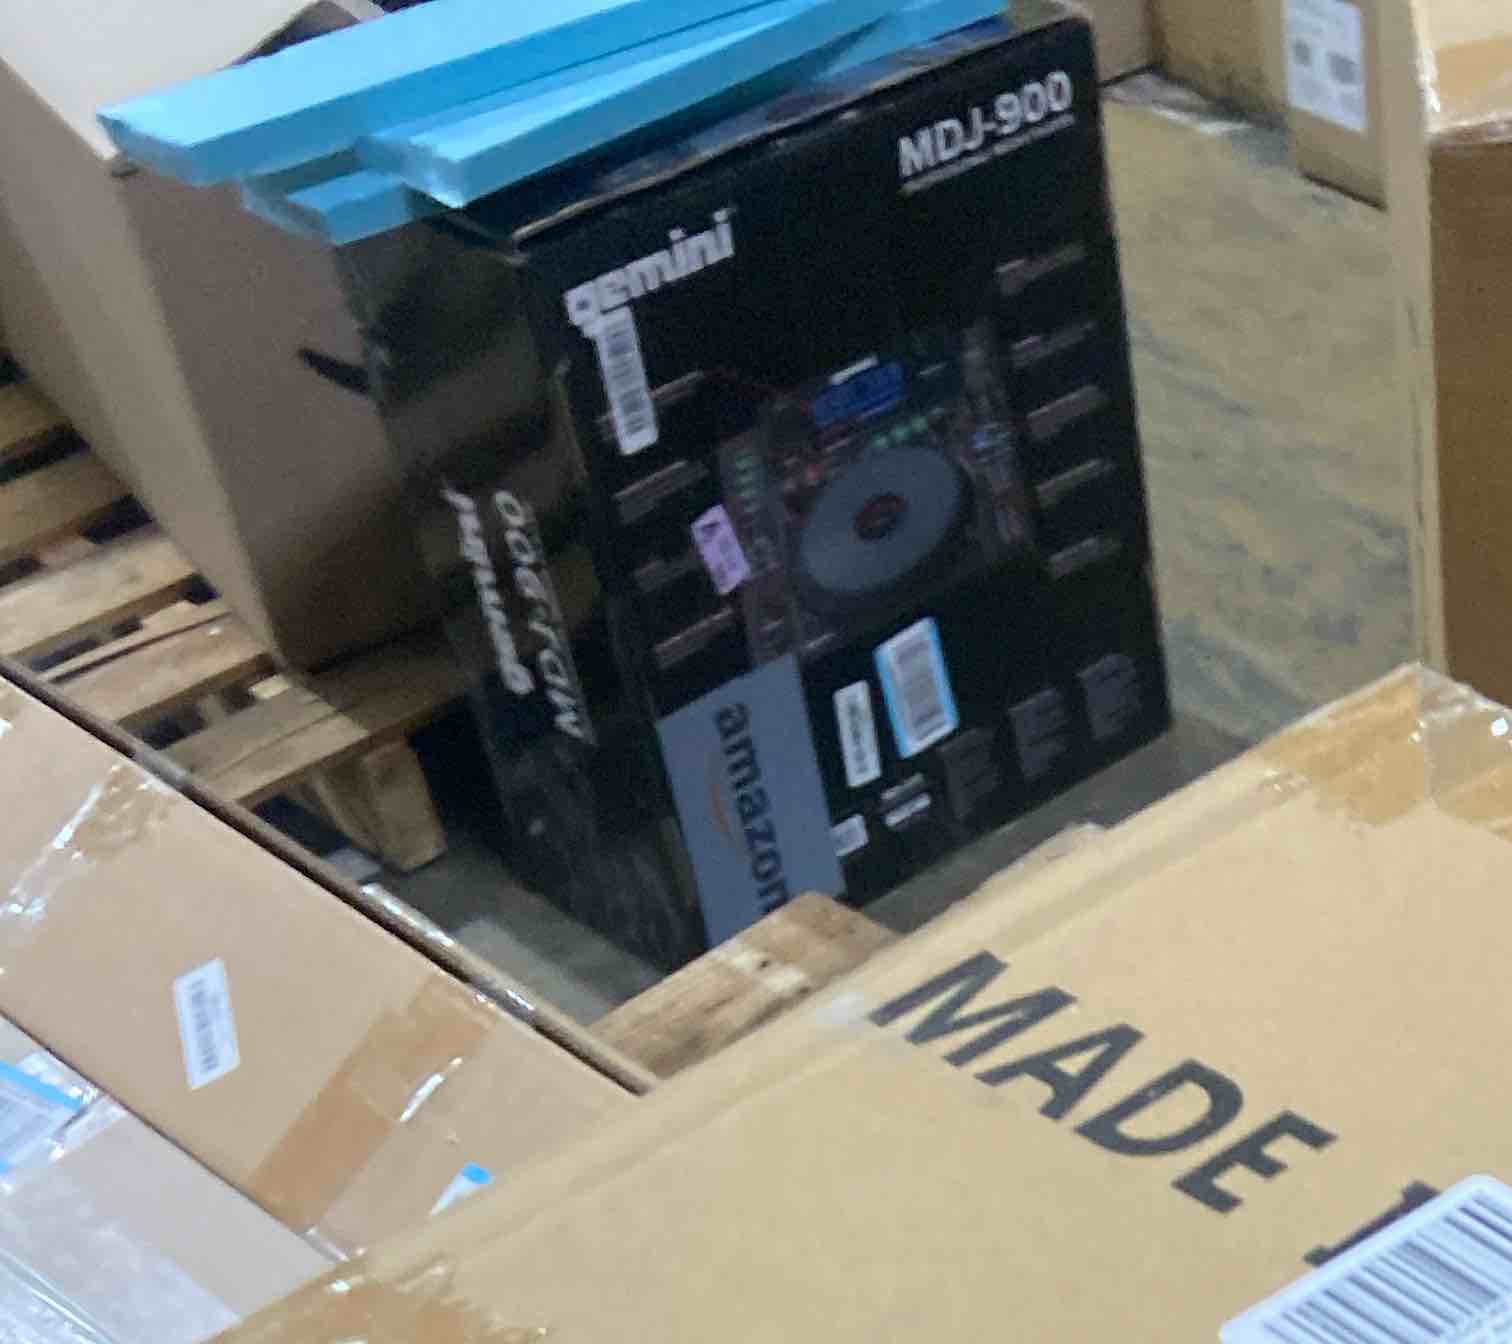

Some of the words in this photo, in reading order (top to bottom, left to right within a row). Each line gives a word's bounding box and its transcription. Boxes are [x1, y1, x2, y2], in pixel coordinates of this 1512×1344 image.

[899, 70, 1073, 176] MDJ-900
[563, 208, 735, 339] gemini
[715, 703, 790, 913] amazon
[869, 950, 1337, 1214] MADE
